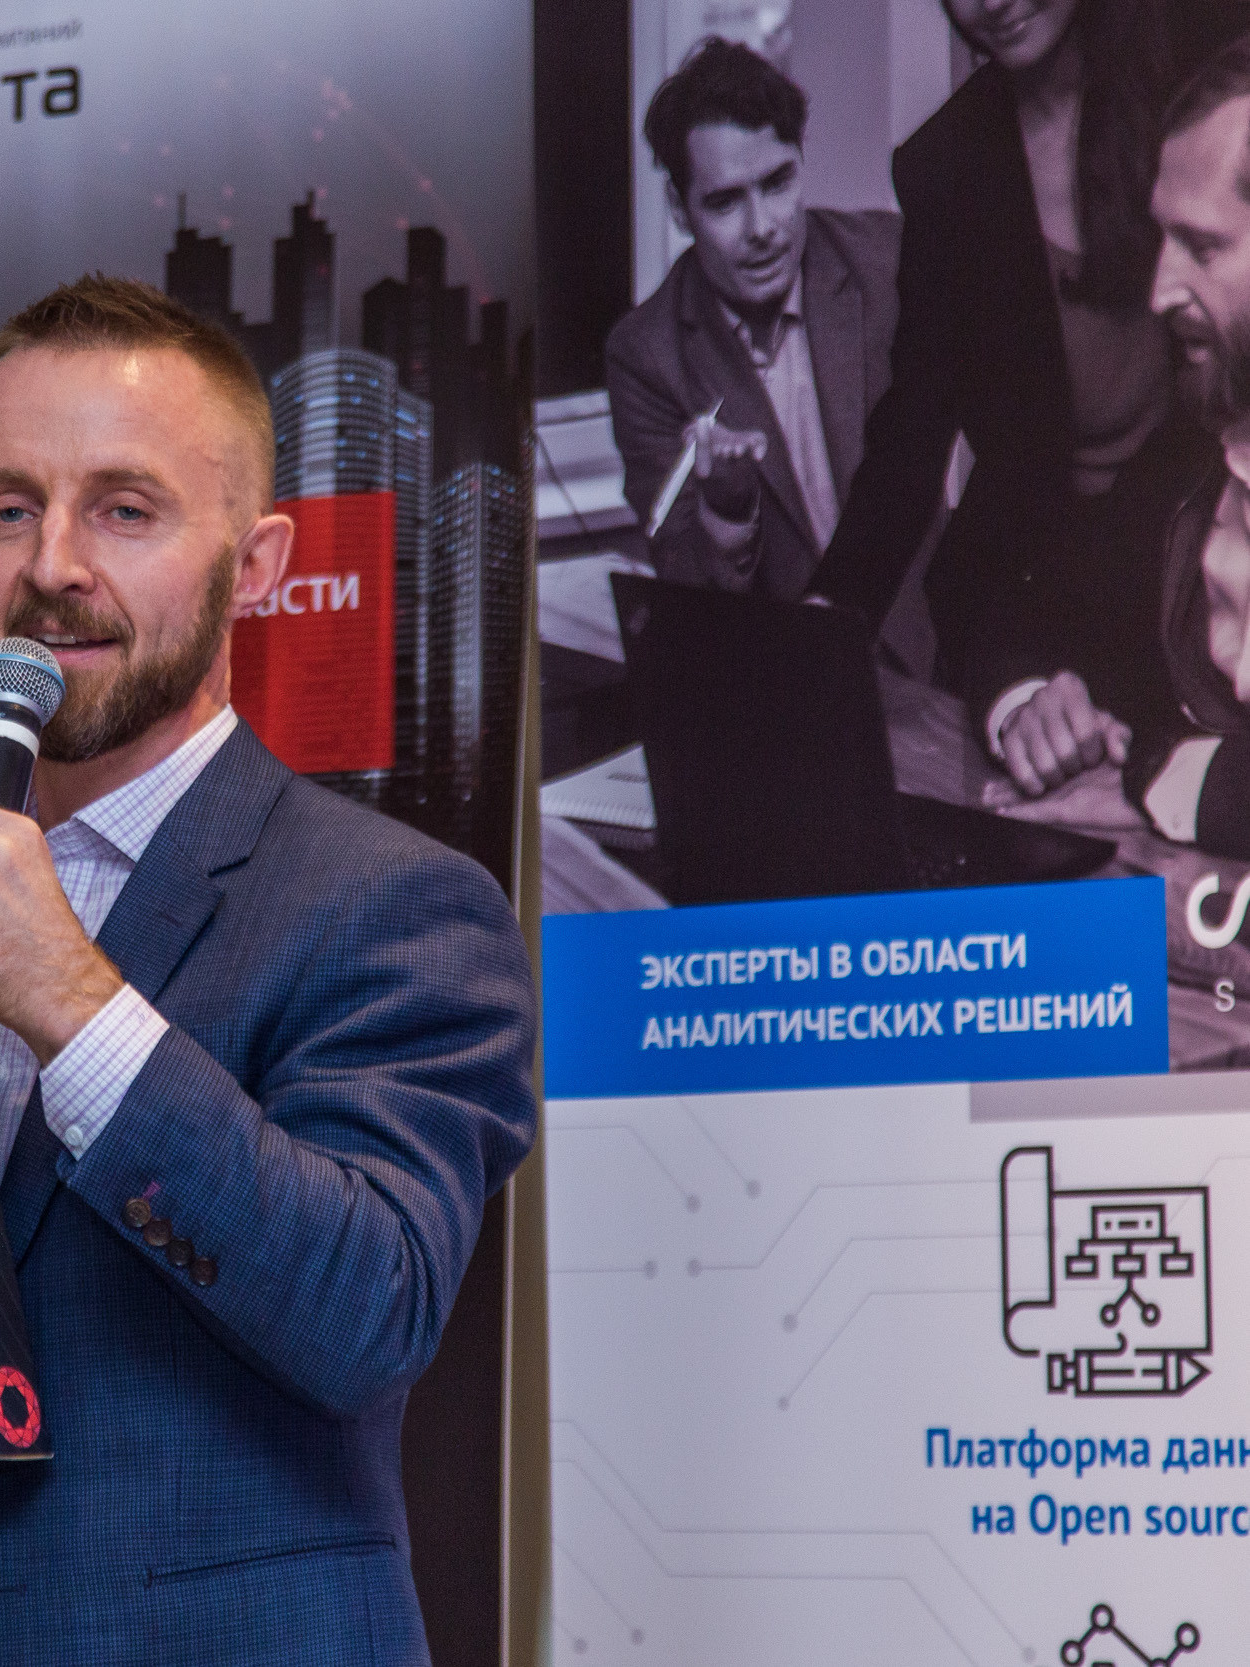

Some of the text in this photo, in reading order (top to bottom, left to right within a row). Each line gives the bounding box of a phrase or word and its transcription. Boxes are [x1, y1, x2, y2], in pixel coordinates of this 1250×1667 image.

[641, 933, 1027, 990] ЭКСПЕРТЫ В ОБЛАСТИ
[641, 983, 1134, 1050] АНАЛИТИЧЕСКИХ РЕШЕНИЙ
[925, 1427, 1150, 1479] Платформа
[971, 1504, 1016, 1535] на
[1028, 1493, 1131, 1546] Open
